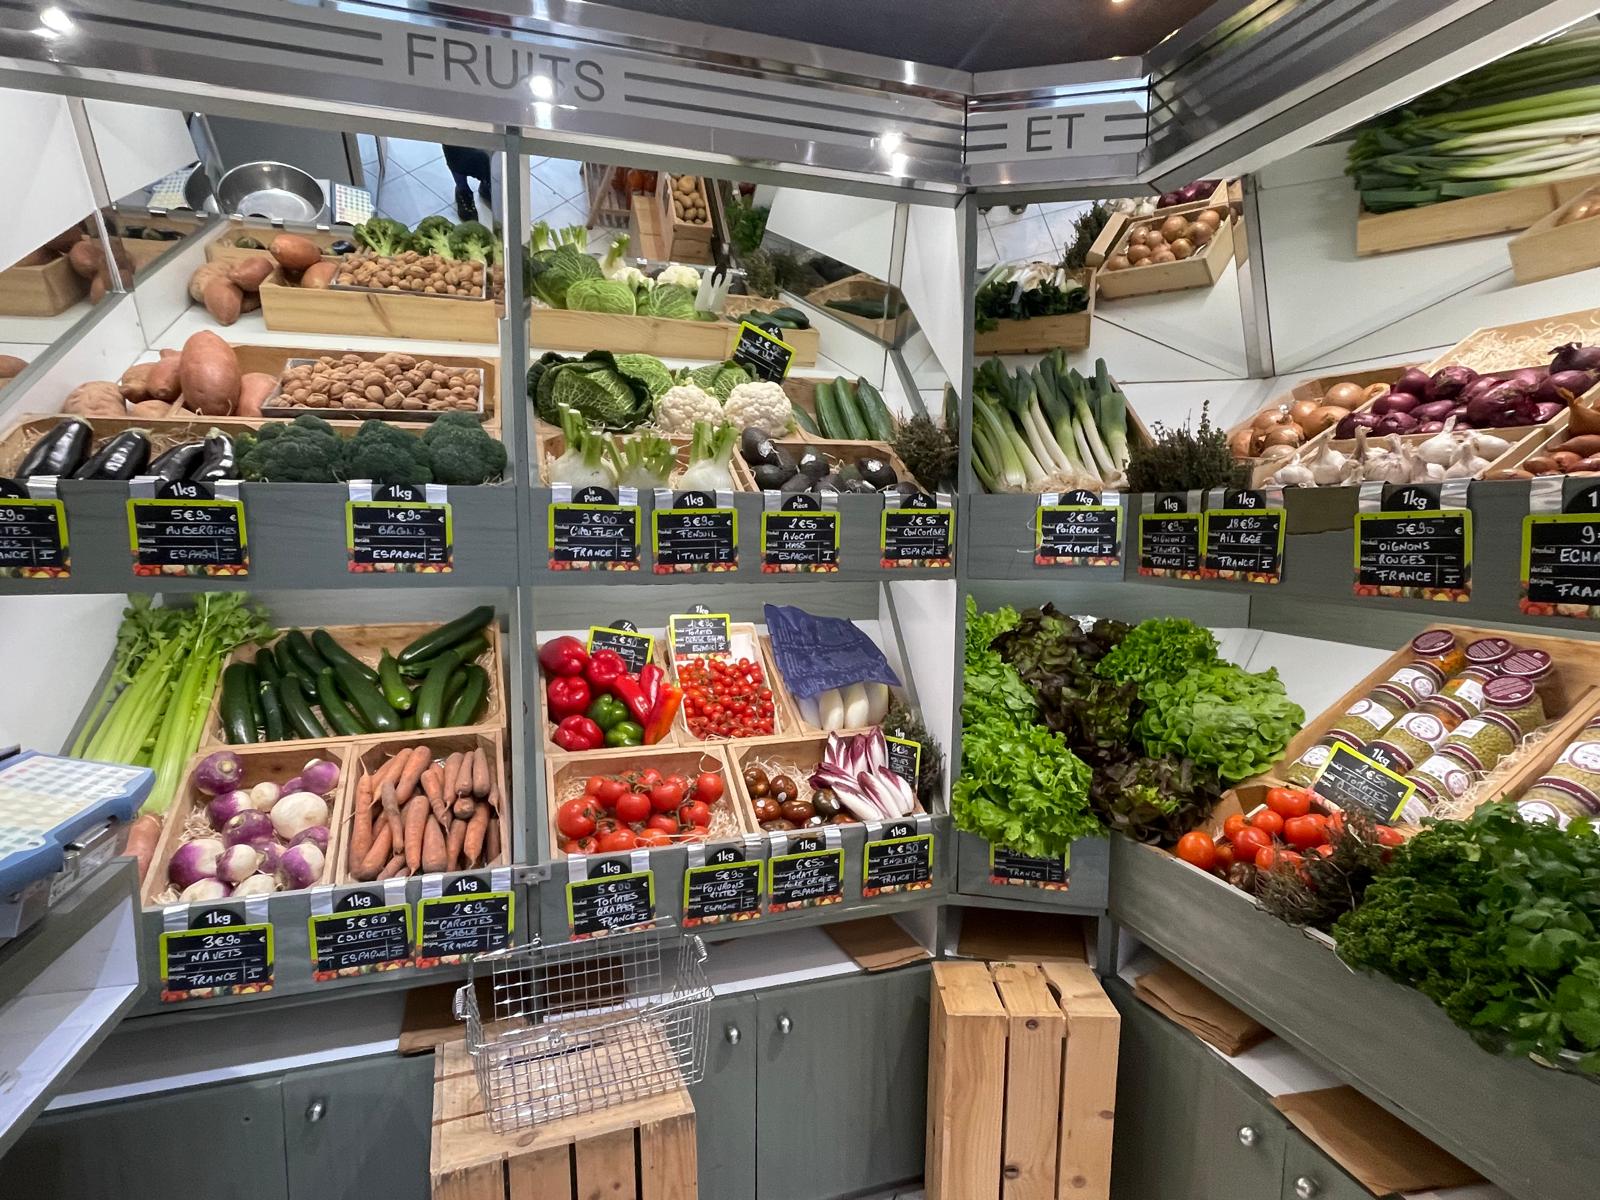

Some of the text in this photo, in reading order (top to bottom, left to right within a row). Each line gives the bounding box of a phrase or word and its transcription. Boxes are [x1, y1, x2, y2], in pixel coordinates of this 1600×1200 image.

[407, 32, 605, 101] FRUITS
[1026, 113, 1085, 152] ET
[170, 481, 197, 497] 1kg
[388, 484, 413, 500] 1kg
[684, 494, 704, 506] 1kg
[1075, 492, 1093, 506] 1kg
[1164, 498, 1178, 511] 1kg
[1238, 492, 1255, 508] 1kg
[1403, 490, 1427, 510] 1kg
[1056, 523, 1099, 534] POIREAUX
[1396, 522, 1435, 536] 5€90
[783, 532, 815, 540] AVOCAT
[569, 547, 612, 558] FRANCE
[1054, 545, 1099, 554] FRANCE
[1379, 541, 1430, 552] OIGNONS
[372, 550, 426, 559] ESPAGNE
[676, 552, 711, 560] ITALIE
[778, 553, 815, 561] ESPAGNE
[1379, 555, 1425, 565] ROUGES
[1151, 557, 1181, 566] FRANCE
[1218, 556, 1255, 567] FRANCE
[1376, 570, 1432, 581] FRANCE
[1371, 748, 1390, 768] 1kg
[1343, 771, 1388, 802] TOMATES
[891, 826, 907, 837] 1kg
[800, 840, 816, 850] 1kg
[717, 850, 735, 862] 1kg
[601, 862, 620, 874] 1kg
[786, 869, 819, 880] TOMATE
[456, 879, 478, 892] 1kg
[703, 880, 745, 893] POIVRONS
[347, 894, 371, 907] 1kg
[593, 892, 638, 907] TOMATES
[206, 912, 231, 925] 1kg
[440, 915, 493, 930] CAROTTES
[598, 913, 637, 927] FRANCE
[202, 935, 241, 948] 3€90
[337, 927, 403, 943] COURGETTES
[439, 940, 479, 951] FRANCE
[191, 948, 242, 962] NAVETS
[341, 950, 387, 964] ESPAGNE
[187, 972, 238, 985] FRANCE
